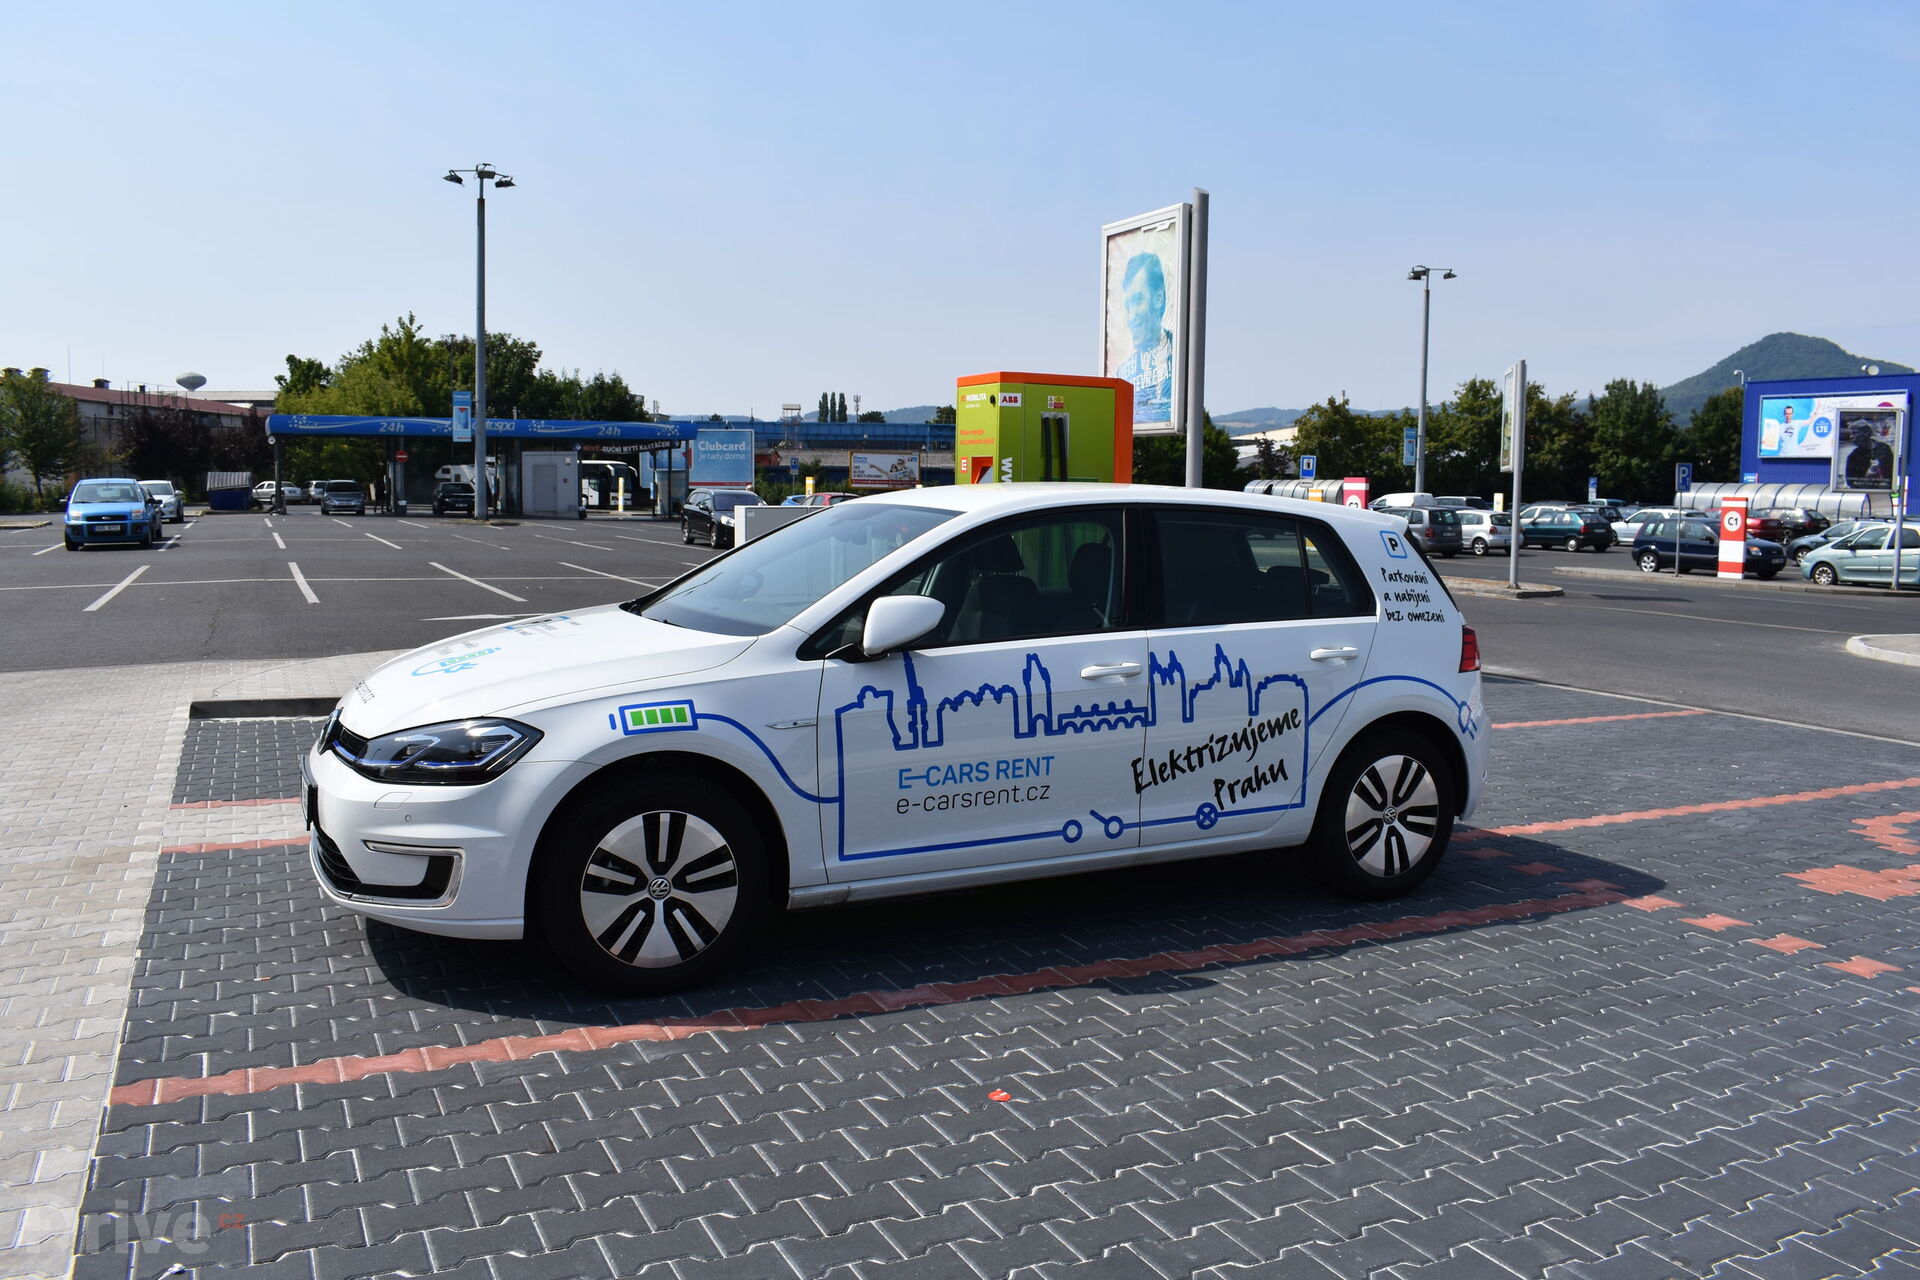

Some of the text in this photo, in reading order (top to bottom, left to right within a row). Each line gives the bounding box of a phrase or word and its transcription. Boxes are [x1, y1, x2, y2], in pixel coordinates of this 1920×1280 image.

[1002, 396, 1018, 404] ABB
[379, 422, 404, 433] 24h
[598, 426, 621, 437] 24h
[1816, 425, 1828, 433] LTE
[698, 441, 746, 451] Clubcard
[1727, 517, 1738, 526] C1
[1388, 537, 1399, 551] P
[1384, 592, 1391, 601] a
[1385, 608, 1403, 622] bez
[1131, 708, 1301, 794] Elektrizujeme
[899, 755, 1055, 790] E-CARS RENT
[1213, 759, 1289, 811] Prahu
[897, 784, 1050, 814] e-carsrent.cz
